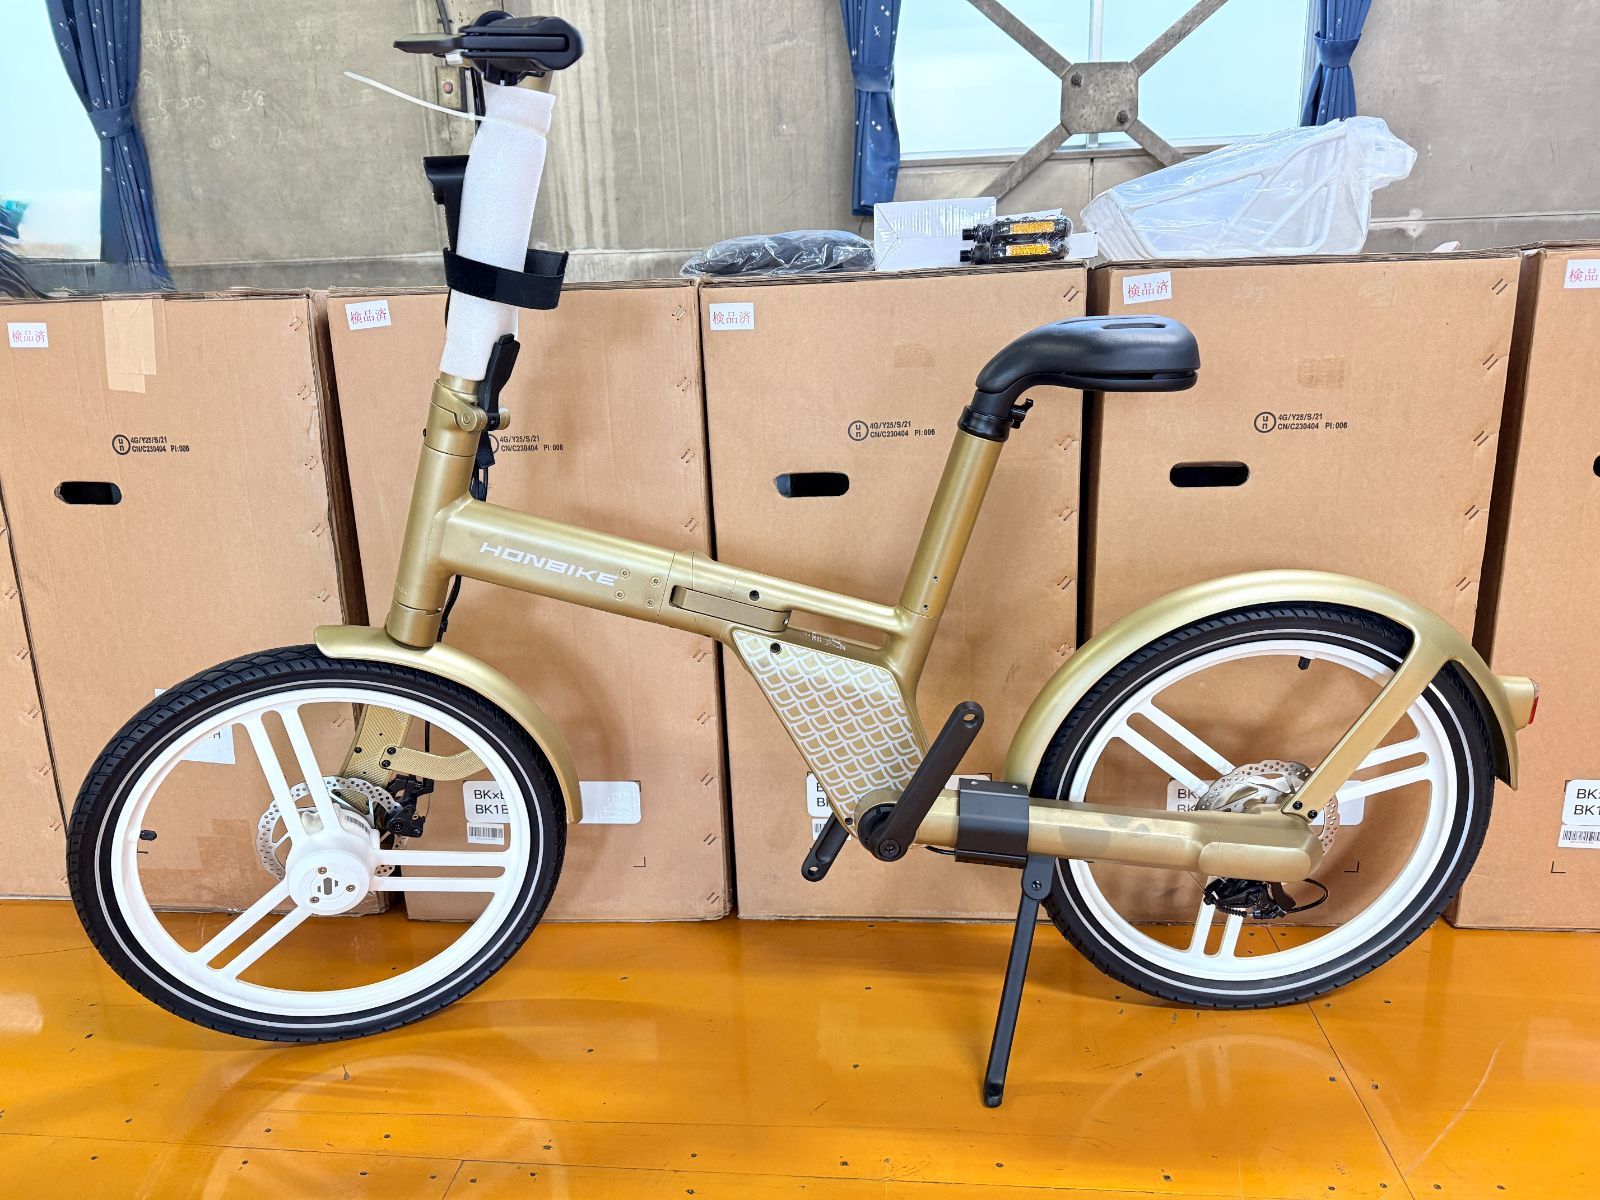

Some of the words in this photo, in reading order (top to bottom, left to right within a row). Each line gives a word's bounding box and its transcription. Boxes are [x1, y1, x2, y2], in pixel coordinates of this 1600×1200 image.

[1127, 280, 1170, 299] 検品済
[350, 308, 387, 324] 検品済
[712, 311, 750, 325] 検品済
[12, 329, 46, 343] 検品済
[1277, 413, 1323, 421] 4G/Y25/S/21
[869, 421, 911, 430] 4G/Y25/S/21
[1277, 422, 1319, 430] CN/C230404
[870, 430, 909, 438] CN/C230404
[914, 429, 935, 437] PI:006
[499, 435, 540, 443] 4G/Y25/S/21
[500, 444, 538, 452] CN/C230404
[480, 542, 617, 587] HONBIKE
